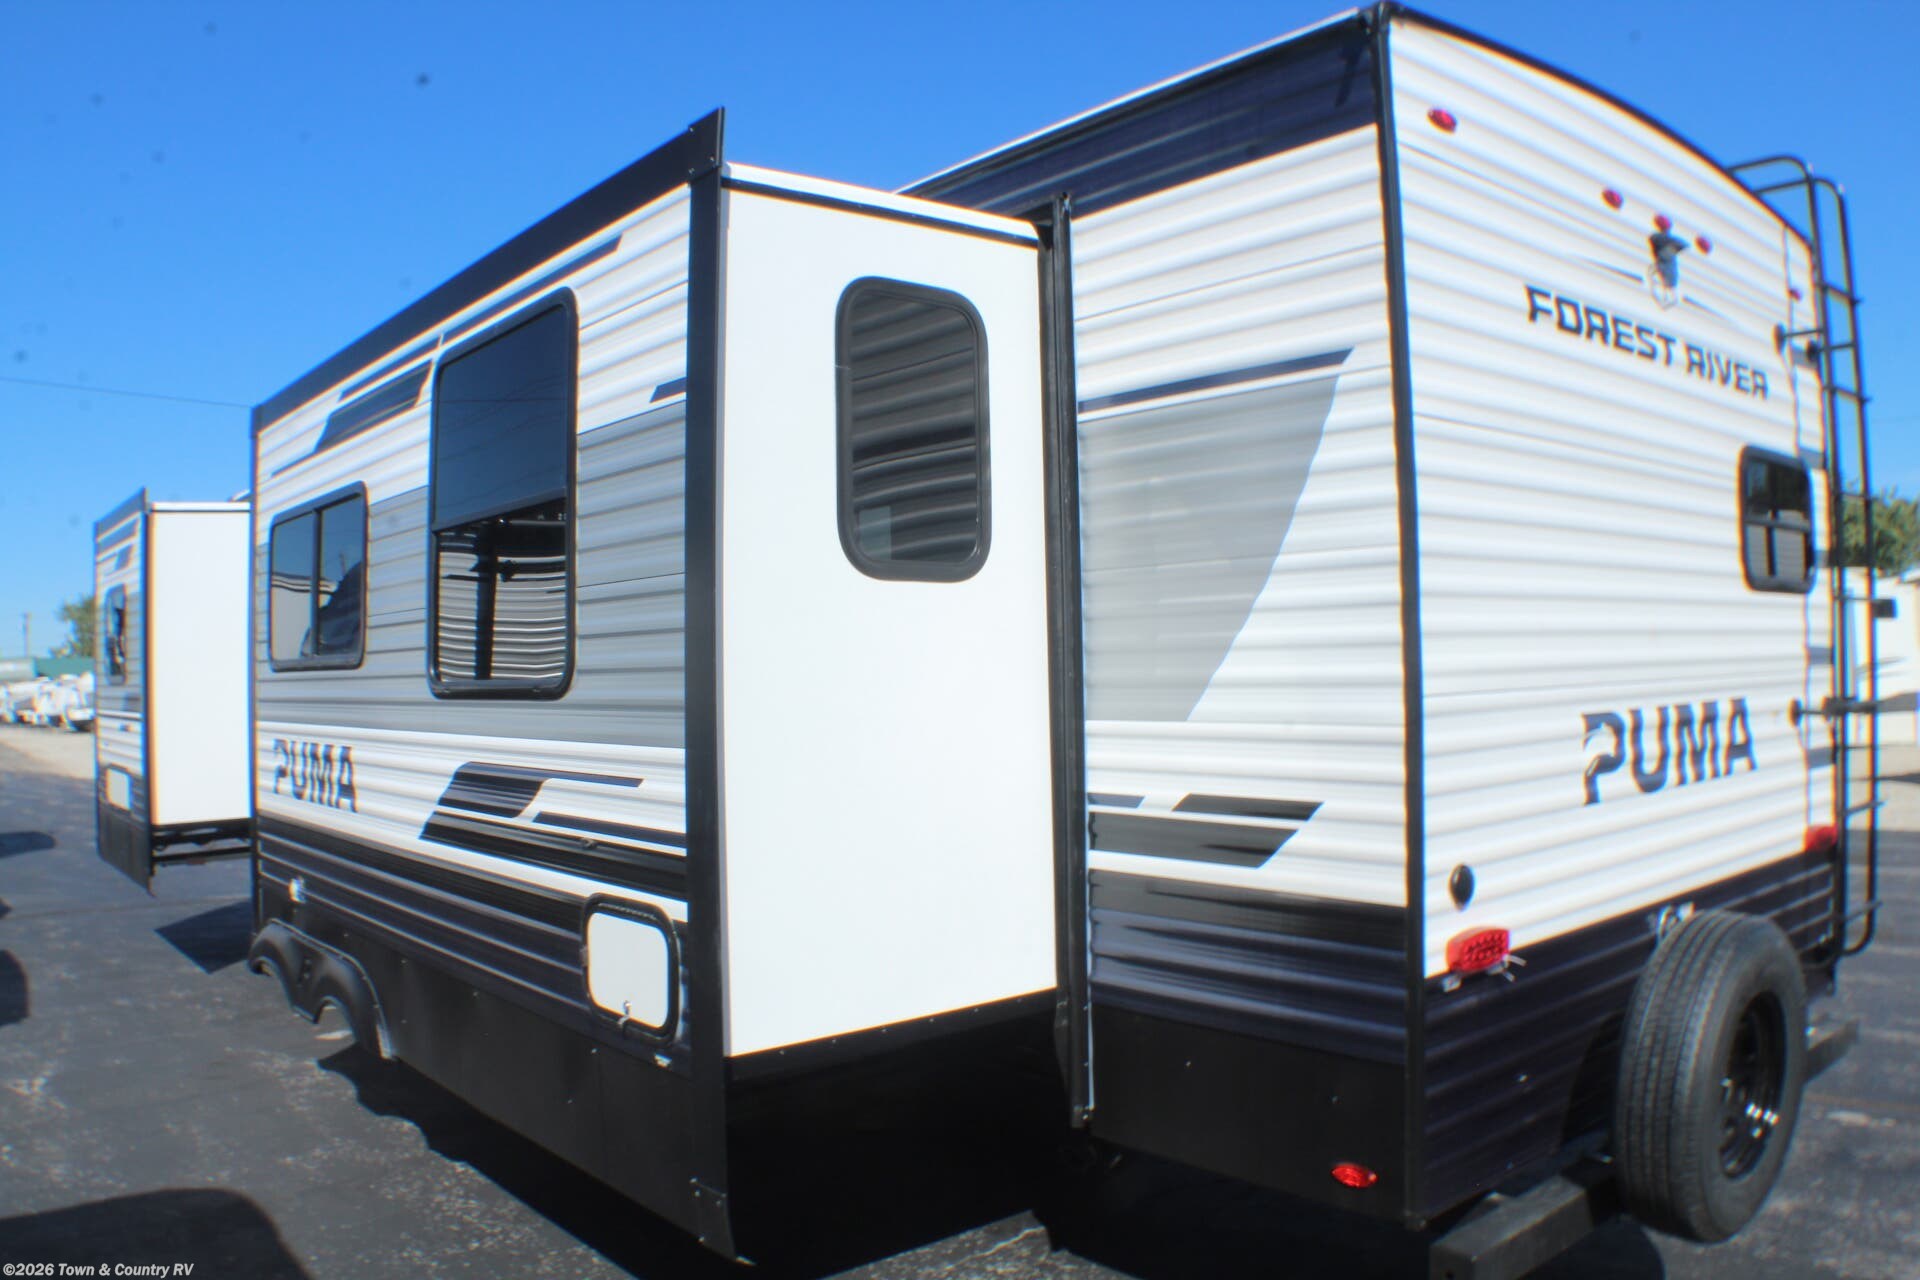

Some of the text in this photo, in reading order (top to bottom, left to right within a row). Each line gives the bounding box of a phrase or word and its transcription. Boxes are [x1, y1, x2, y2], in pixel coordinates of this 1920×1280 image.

[1525, 284, 1769, 400] FOREST RIVER
[272, 738, 358, 813] PUMA
[1581, 697, 1758, 806] PUMA
